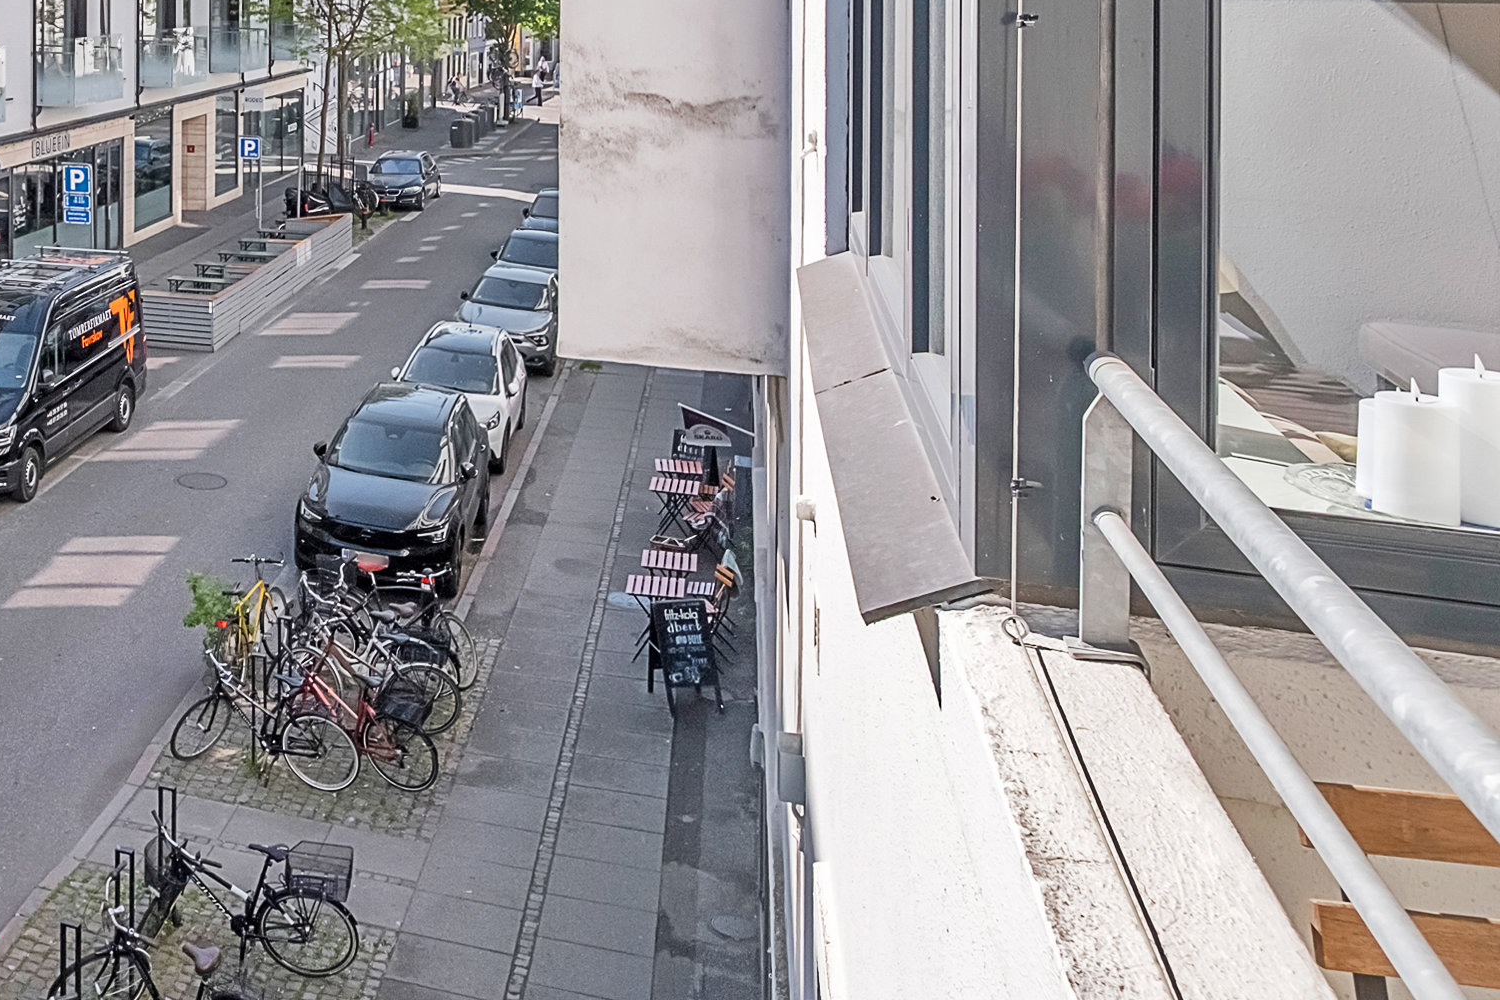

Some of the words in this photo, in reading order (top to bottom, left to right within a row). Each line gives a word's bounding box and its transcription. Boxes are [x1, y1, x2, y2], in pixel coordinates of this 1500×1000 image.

[35, 132, 70, 156] BLUEFIN
[244, 140, 256, 156] P
[70, 169, 85, 190] P
